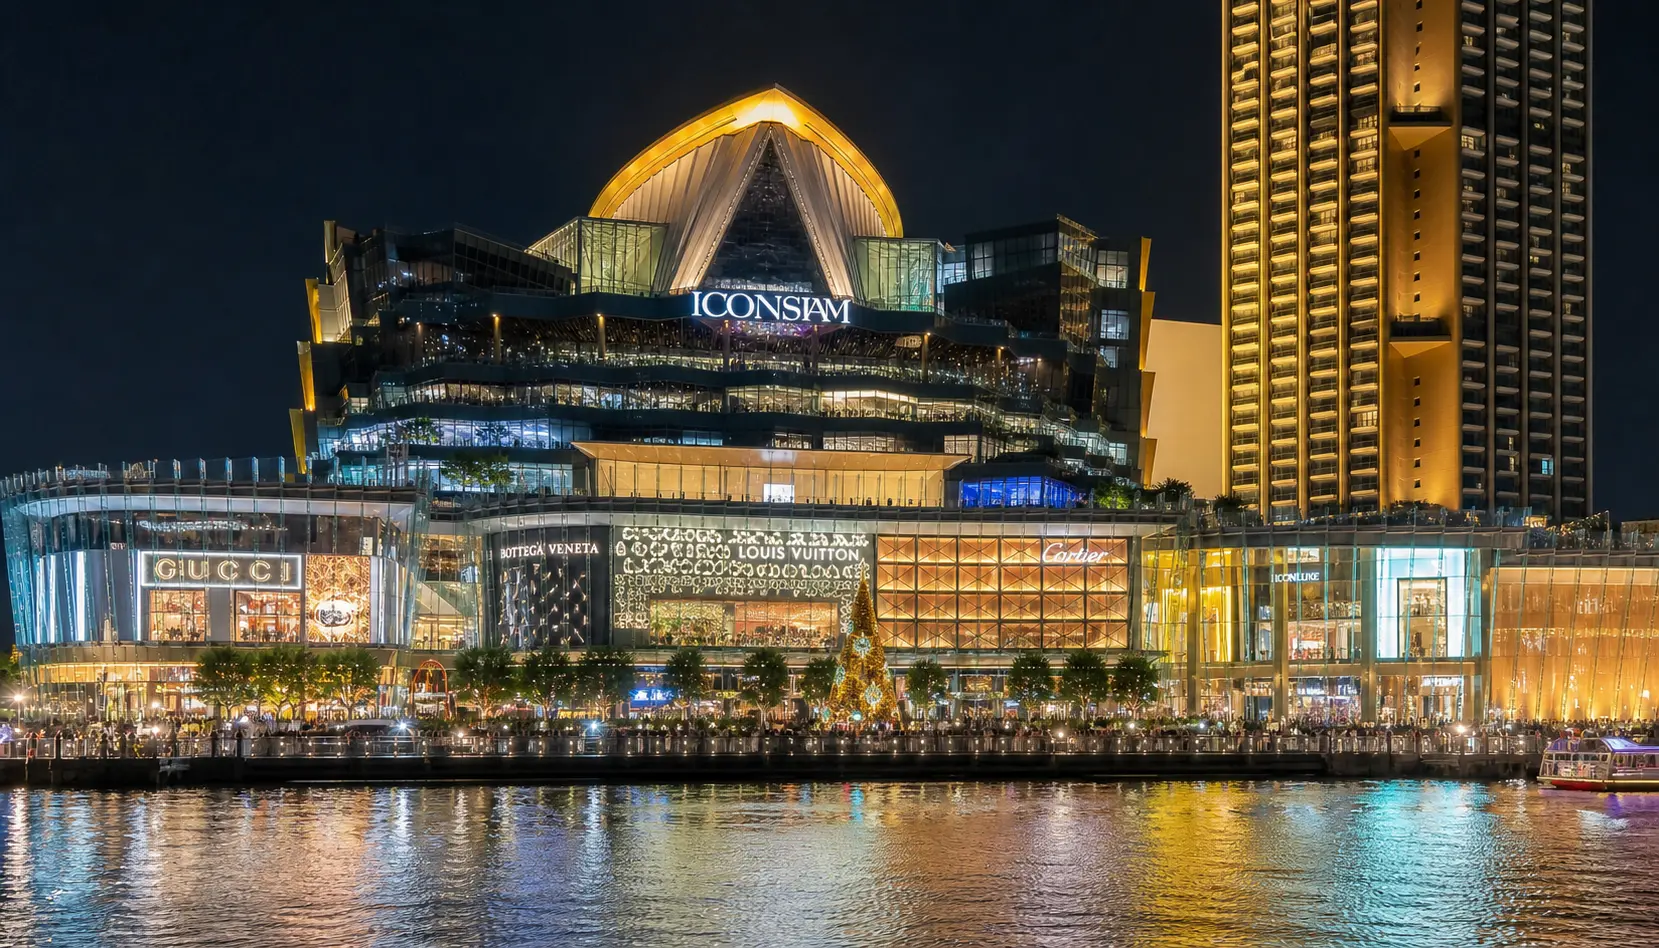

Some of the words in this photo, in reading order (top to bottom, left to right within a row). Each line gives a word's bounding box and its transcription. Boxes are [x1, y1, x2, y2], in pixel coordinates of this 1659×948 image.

[692, 291, 851, 323] ICONSIAM
[501, 543, 543, 559] BOTTEGA
[549, 543, 599, 555] VENETA
[739, 546, 785, 559] LOUIS
[791, 547, 859, 561] VUITTON
[1042, 542, 1109, 563] Cartier
[155, 558, 291, 582] GUCCI
